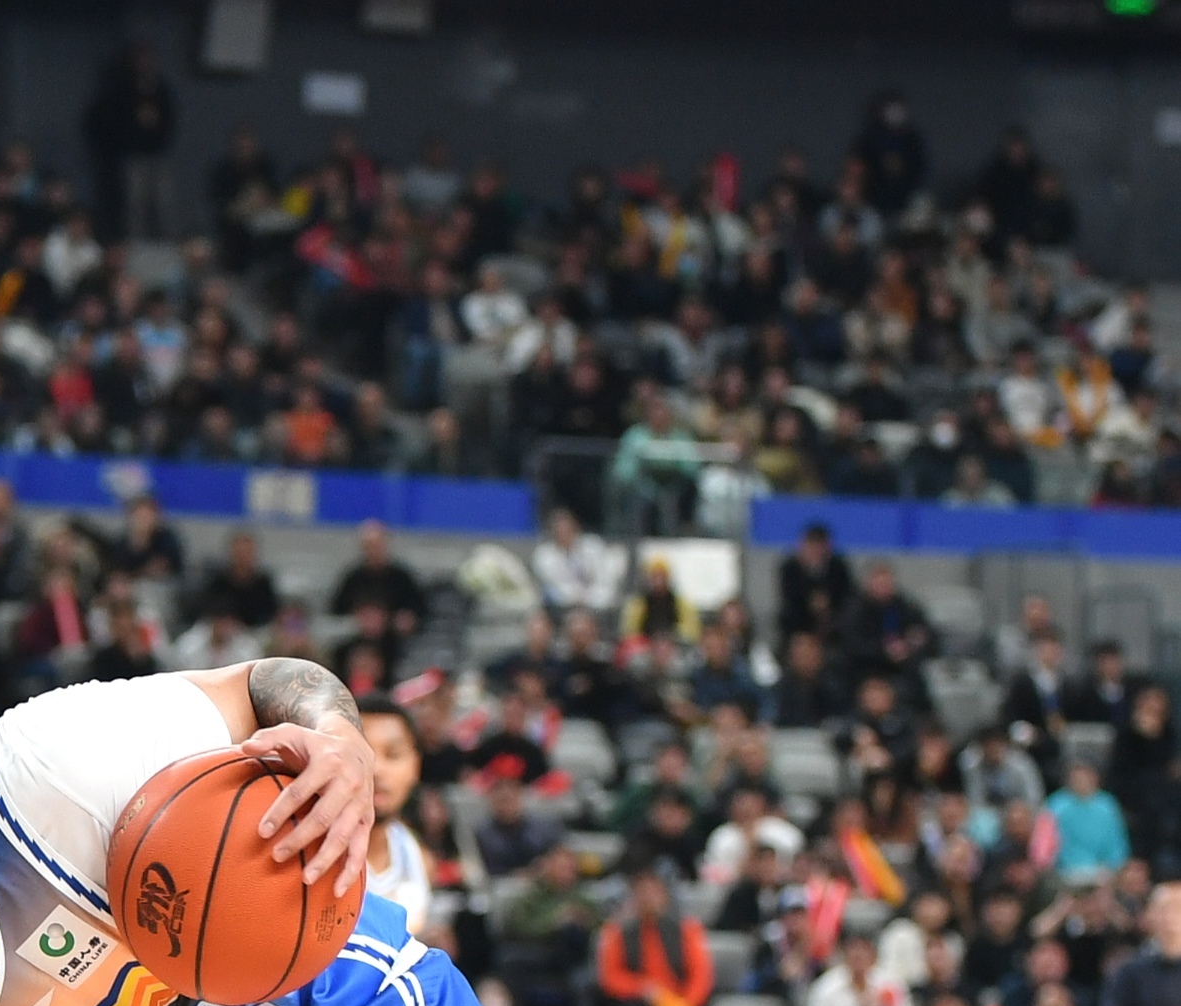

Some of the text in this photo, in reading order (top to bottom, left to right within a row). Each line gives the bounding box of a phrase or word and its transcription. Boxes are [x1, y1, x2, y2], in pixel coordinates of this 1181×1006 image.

[58, 936, 101, 978] 中国人寿
[68, 942, 109, 983] CHINA LIFE
